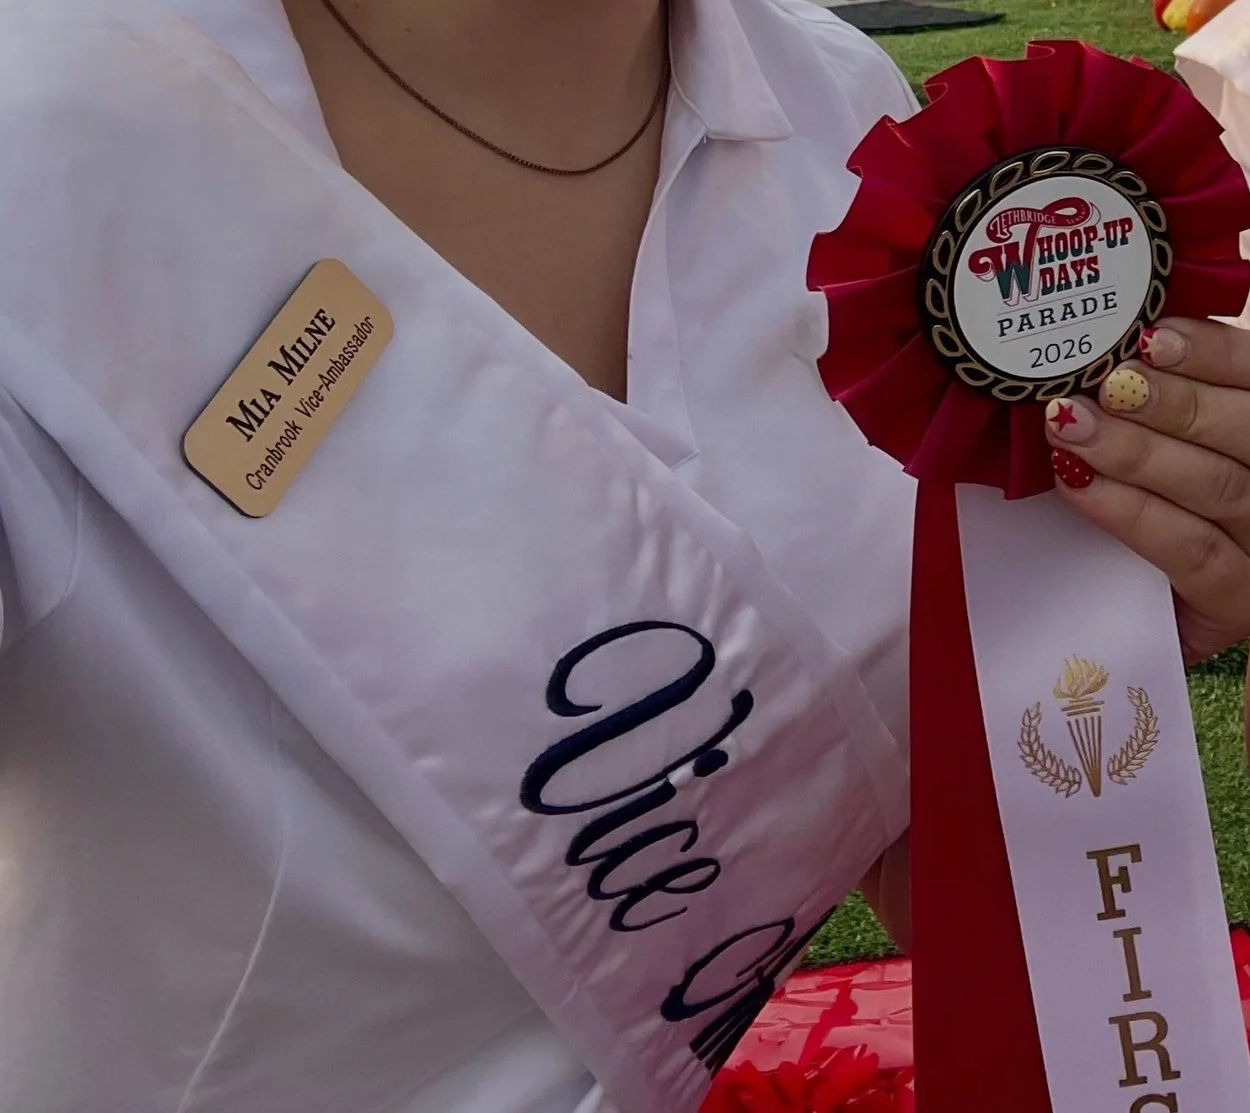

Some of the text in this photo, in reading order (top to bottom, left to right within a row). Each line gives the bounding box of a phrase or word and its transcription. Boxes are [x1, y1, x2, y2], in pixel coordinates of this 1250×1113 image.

[989, 209, 1057, 239] LETHBRIDGE
[968, 217, 1134, 300] WHOOP-UP
[1039, 255, 1101, 296] DAYS
[996, 291, 1118, 338] PARADE
[1029, 334, 1093, 369] 2026
[245, 315, 375, 491] Cranbrook Vice-Ambassador
[519, 620, 754, 933] Vice
[1086, 843, 1182, 1113] FIR
